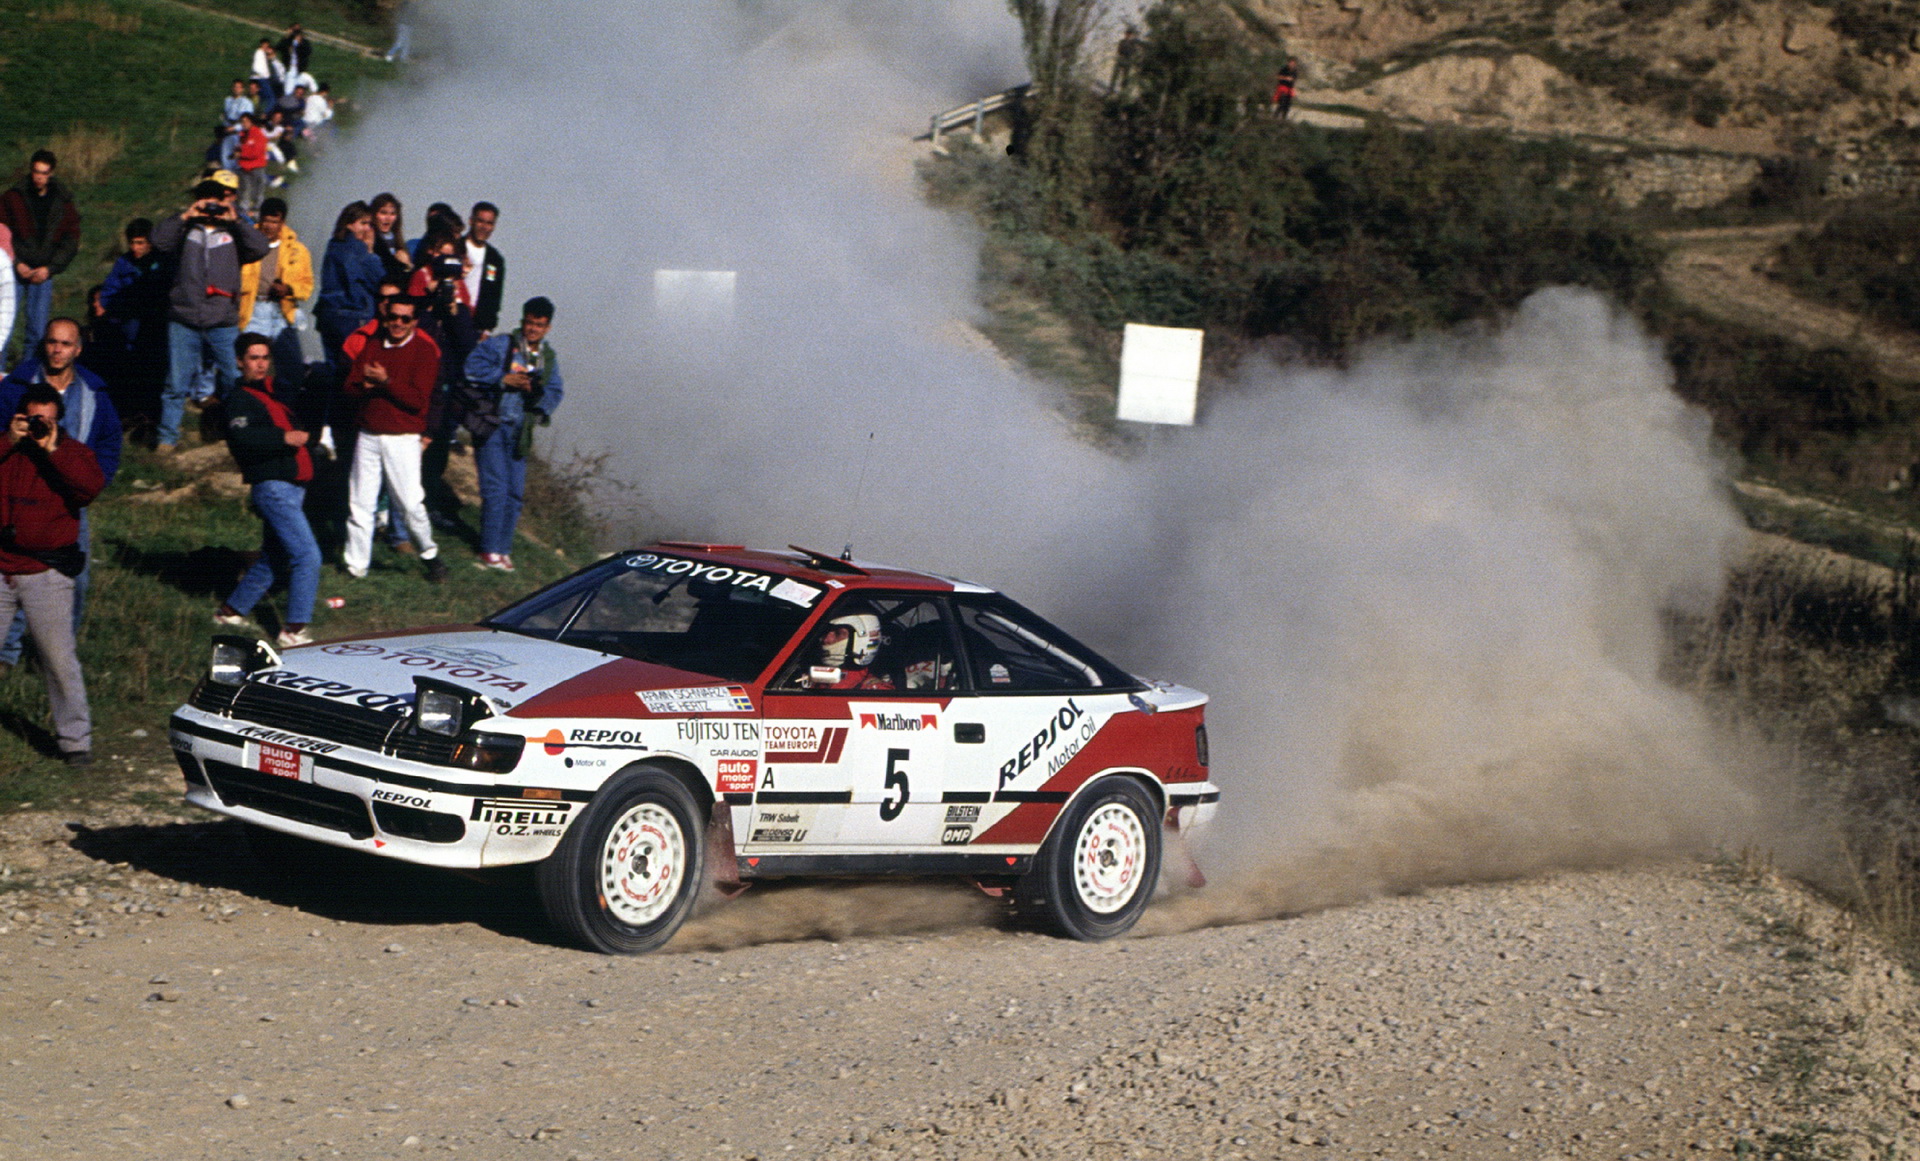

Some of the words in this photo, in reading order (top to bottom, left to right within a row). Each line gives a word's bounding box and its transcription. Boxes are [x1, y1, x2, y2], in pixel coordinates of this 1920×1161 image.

[652, 557, 771, 592] TOYOTA
[382, 652, 528, 692] TOYOTA
[641, 690, 674, 701] ARMIN
[675, 687, 724, 699] SCHWARZ
[649, 701, 677, 712] ARNE
[678, 700, 712, 711] HERTZ
[877, 713, 921, 731] Marlboro
[570, 729, 642, 744] REPSOL
[677, 719, 729, 745] FUJITSU
[733, 722, 760, 741] TEN
[765, 727, 817, 739] TOYOTA
[765, 740, 785, 750] TEAM
[787, 740, 817, 750] EUROPE
[1000, 697, 1084, 790] REPSOL
[1047, 738, 1079, 777] Motor
[1081, 716, 1097, 742] Oil
[262, 745, 294, 761] auto
[710, 749, 729, 757] CAR
[731, 749, 758, 757] AUDIO
[264, 757, 297, 770] motor
[575, 759, 594, 767] Motor
[596, 758, 607, 767] Oil
[719, 762, 750, 774] auto
[721, 773, 753, 782] motor
[761, 767, 775, 789] A
[880, 748, 910, 822] 5
[372, 789, 432, 808] REPSOL
[469, 798, 572, 825] PIRELLI
[759, 812, 777, 822] TRW
[946, 805, 982, 817] BILSTEIN
[496, 824, 531, 837] O.Z.
[533, 828, 561, 837] WHEELS
[943, 828, 971, 842] OMP
